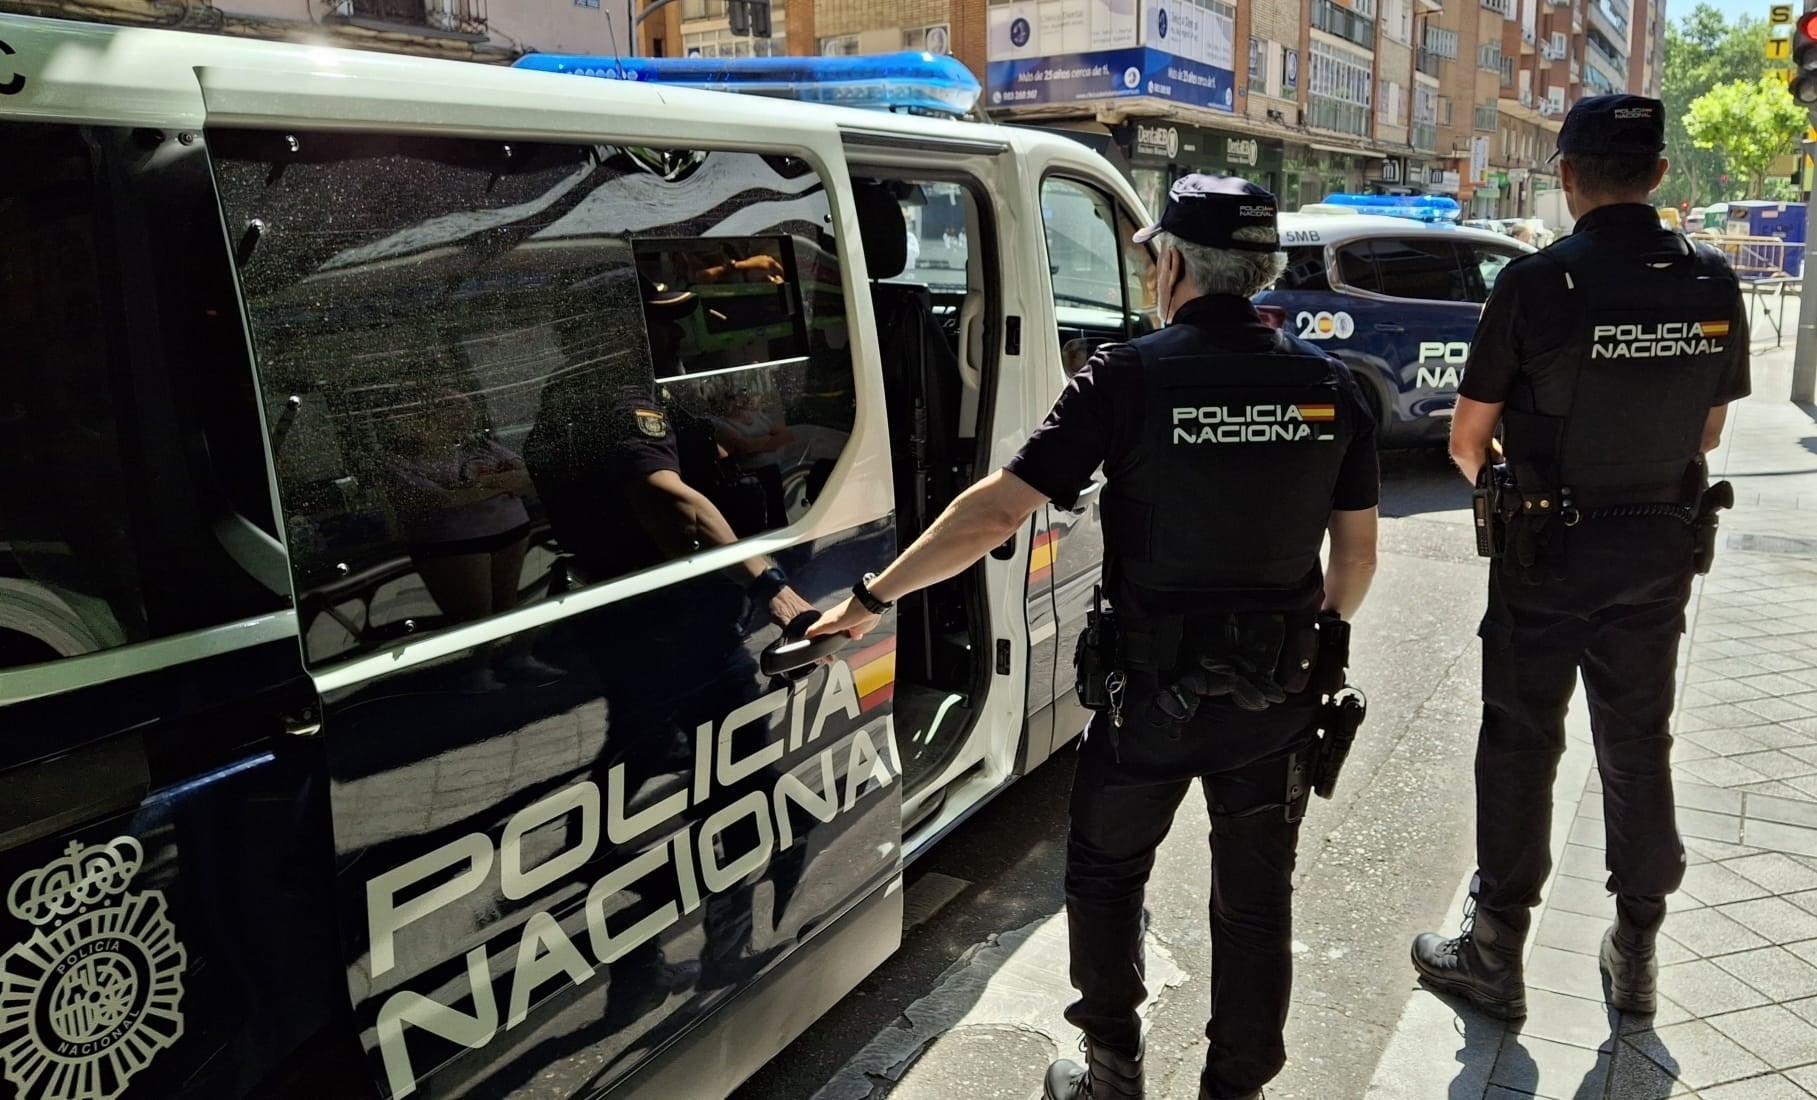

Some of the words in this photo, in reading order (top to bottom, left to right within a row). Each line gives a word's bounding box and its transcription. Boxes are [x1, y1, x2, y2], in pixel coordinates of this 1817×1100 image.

[1044, 69, 1053, 80] 25
[1071, 68, 1091, 78] cerca
[1092, 65, 1102, 77] de
[1286, 230, 1320, 242] 5MB
[1593, 322, 1705, 341] POLICIA
[1418, 341, 1472, 364] PO
[1591, 338, 1724, 359] NACIONAL
[1416, 366, 1464, 389] NA
[1172, 404, 1303, 425] POLICIA
[1173, 424, 1335, 444] NACIONAL
[366, 660, 862, 978] POLICIA
[57, 1009, 140, 1056] NACIONAL
